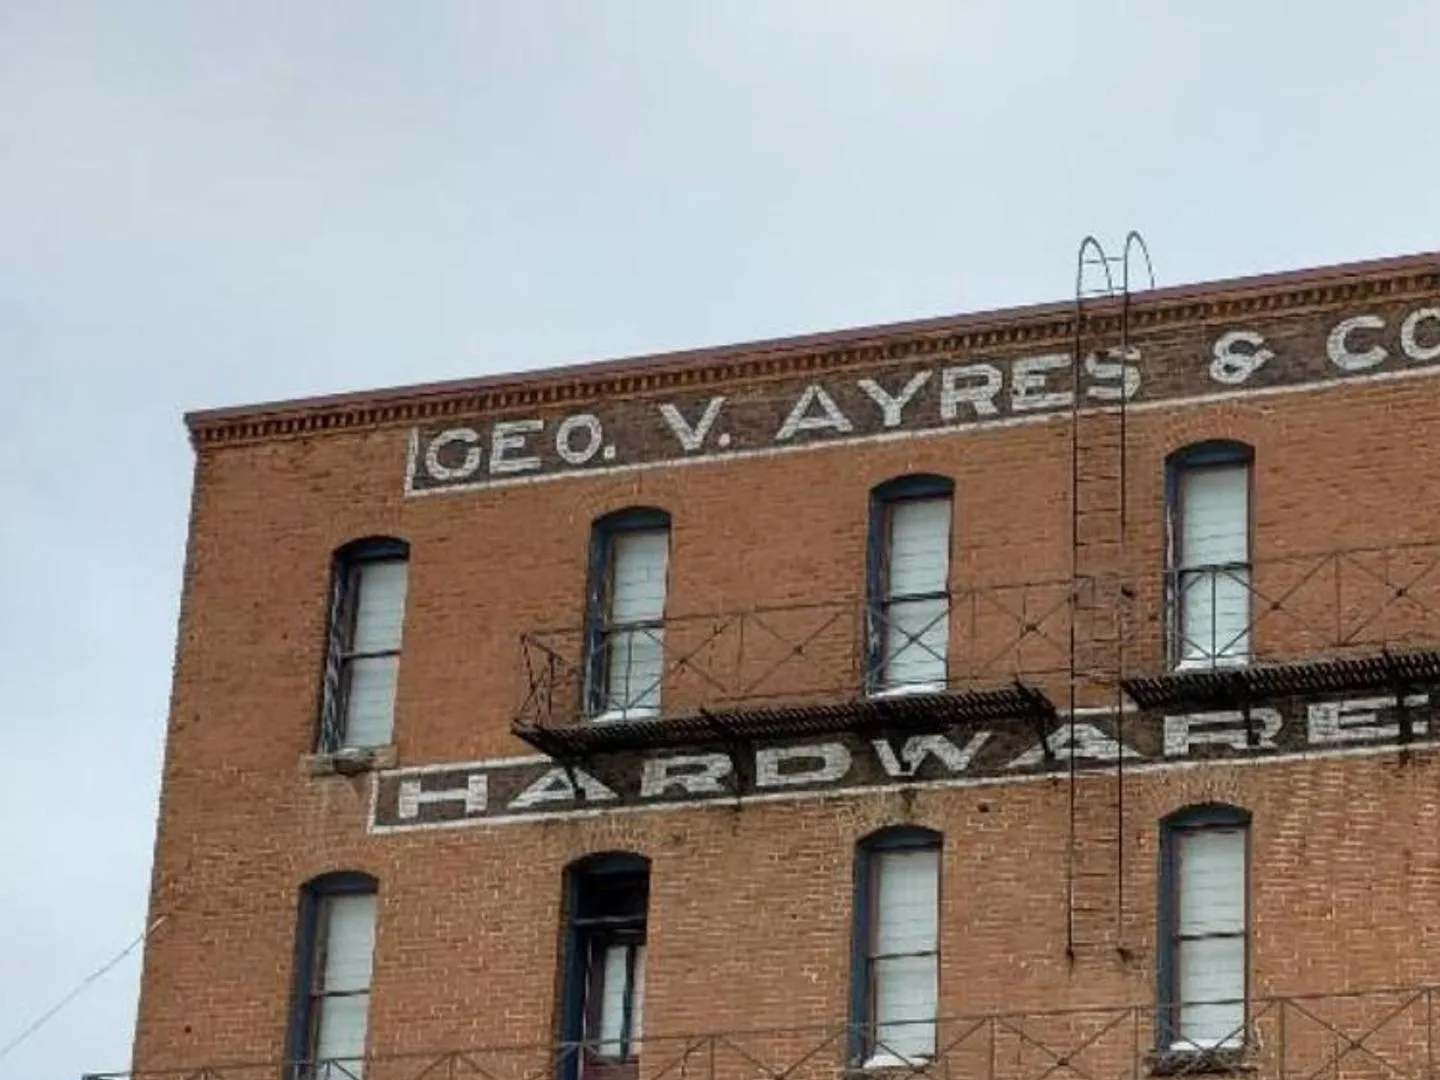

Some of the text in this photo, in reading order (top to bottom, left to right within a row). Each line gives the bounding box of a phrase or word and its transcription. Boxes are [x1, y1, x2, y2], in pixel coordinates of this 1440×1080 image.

[424, 413, 616, 482] GEO.
[659, 396, 731, 451] V.
[774, 347, 1142, 443] AYRES
[1208, 331, 1276, 386] &
